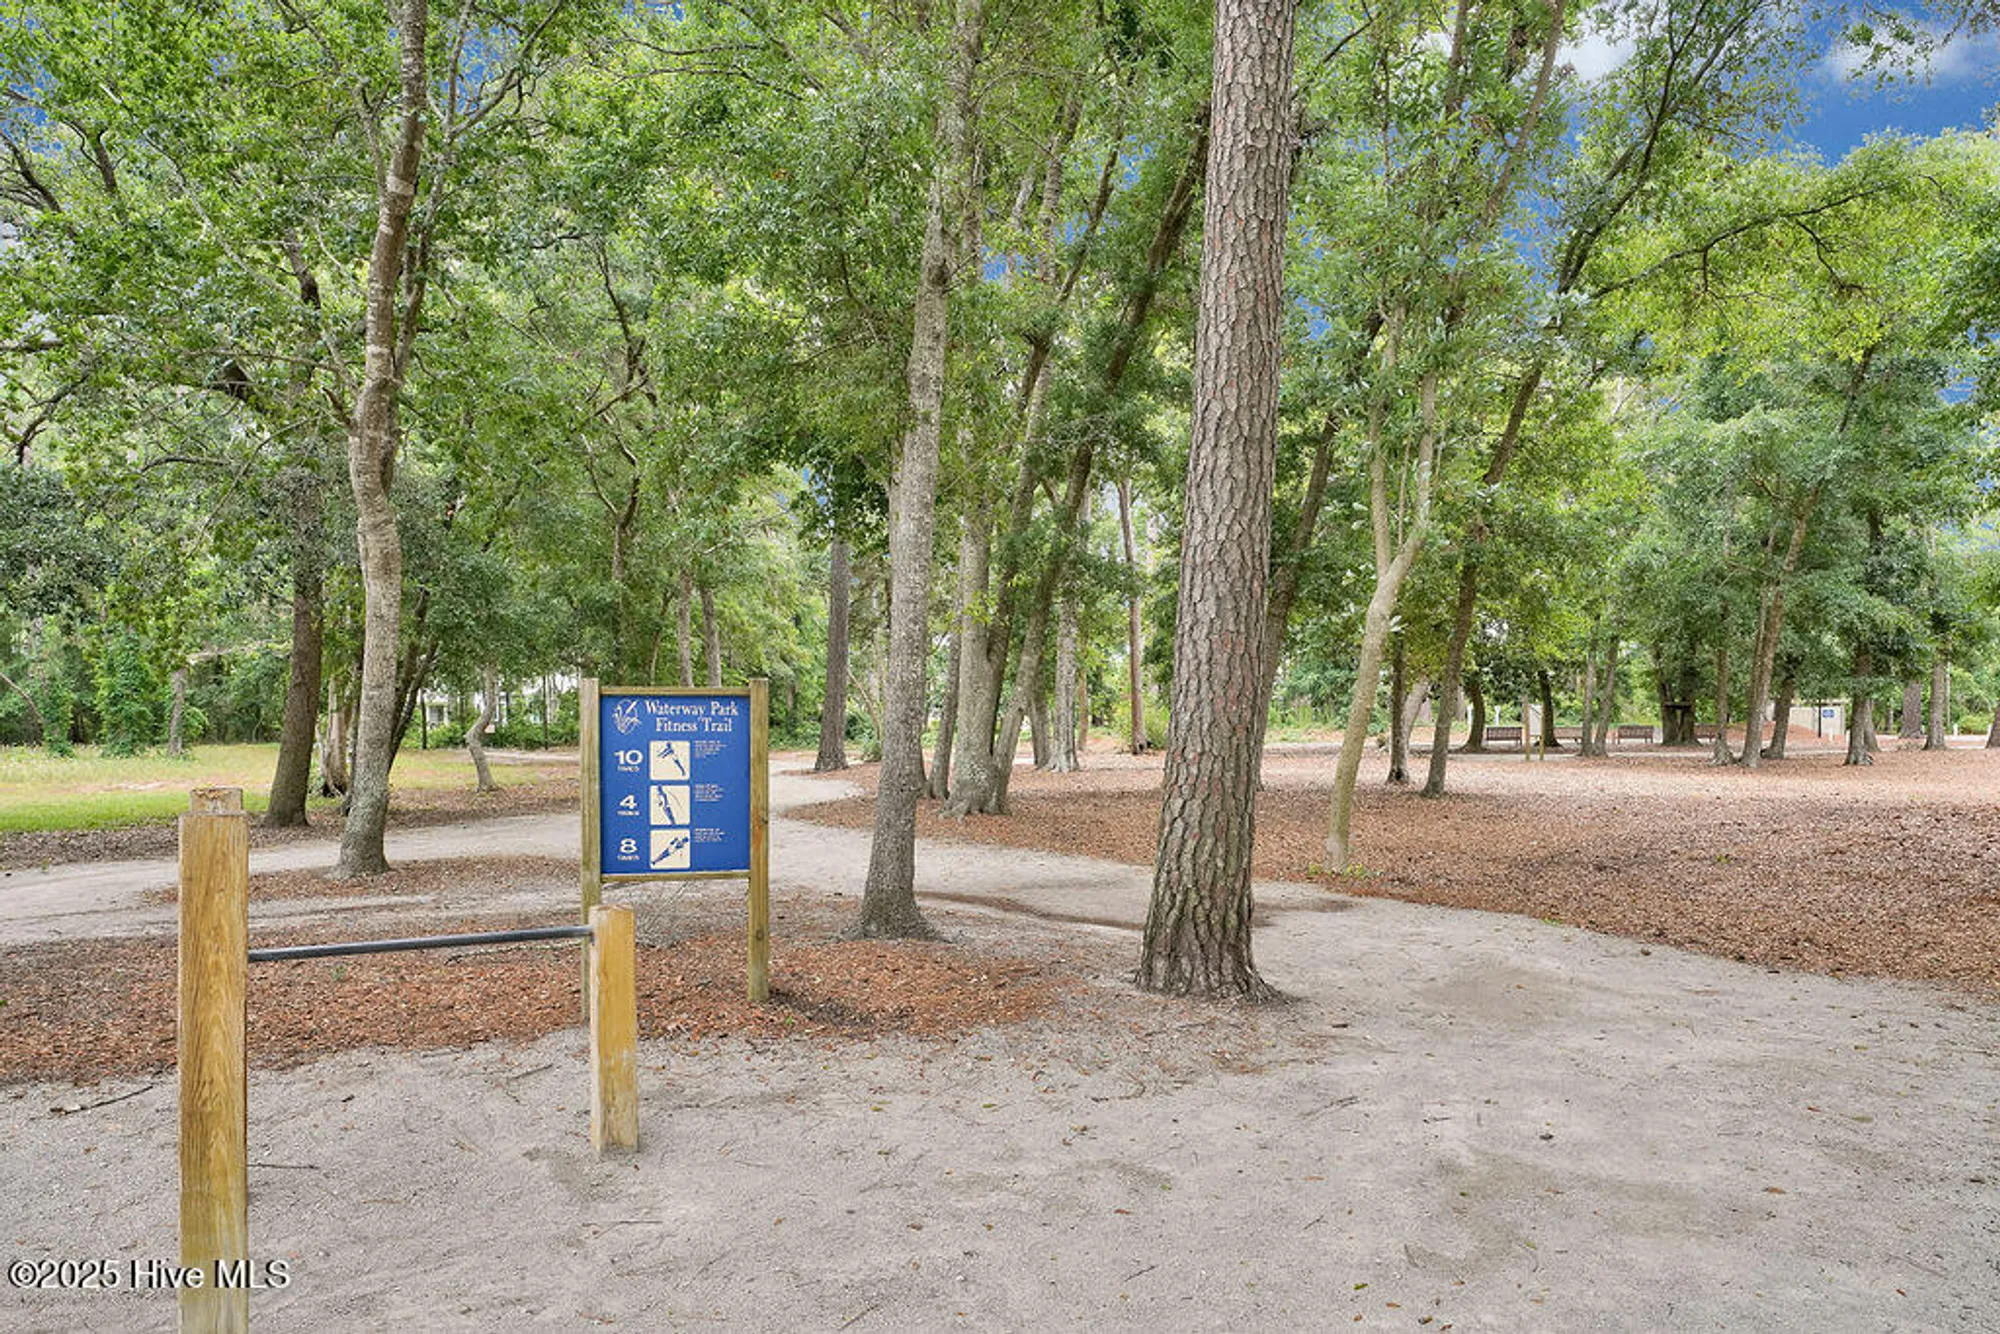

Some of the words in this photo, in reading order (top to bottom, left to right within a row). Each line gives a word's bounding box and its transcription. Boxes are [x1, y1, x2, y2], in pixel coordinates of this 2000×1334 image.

[645, 700, 706, 717] Waterway
[711, 701, 738, 716] Park
[656, 718, 698, 732] Fitness
[699, 717, 732, 732] Trail
[614, 750, 643, 765] 10
[619, 795, 637, 809] 4
[620, 838, 637, 853] 8
